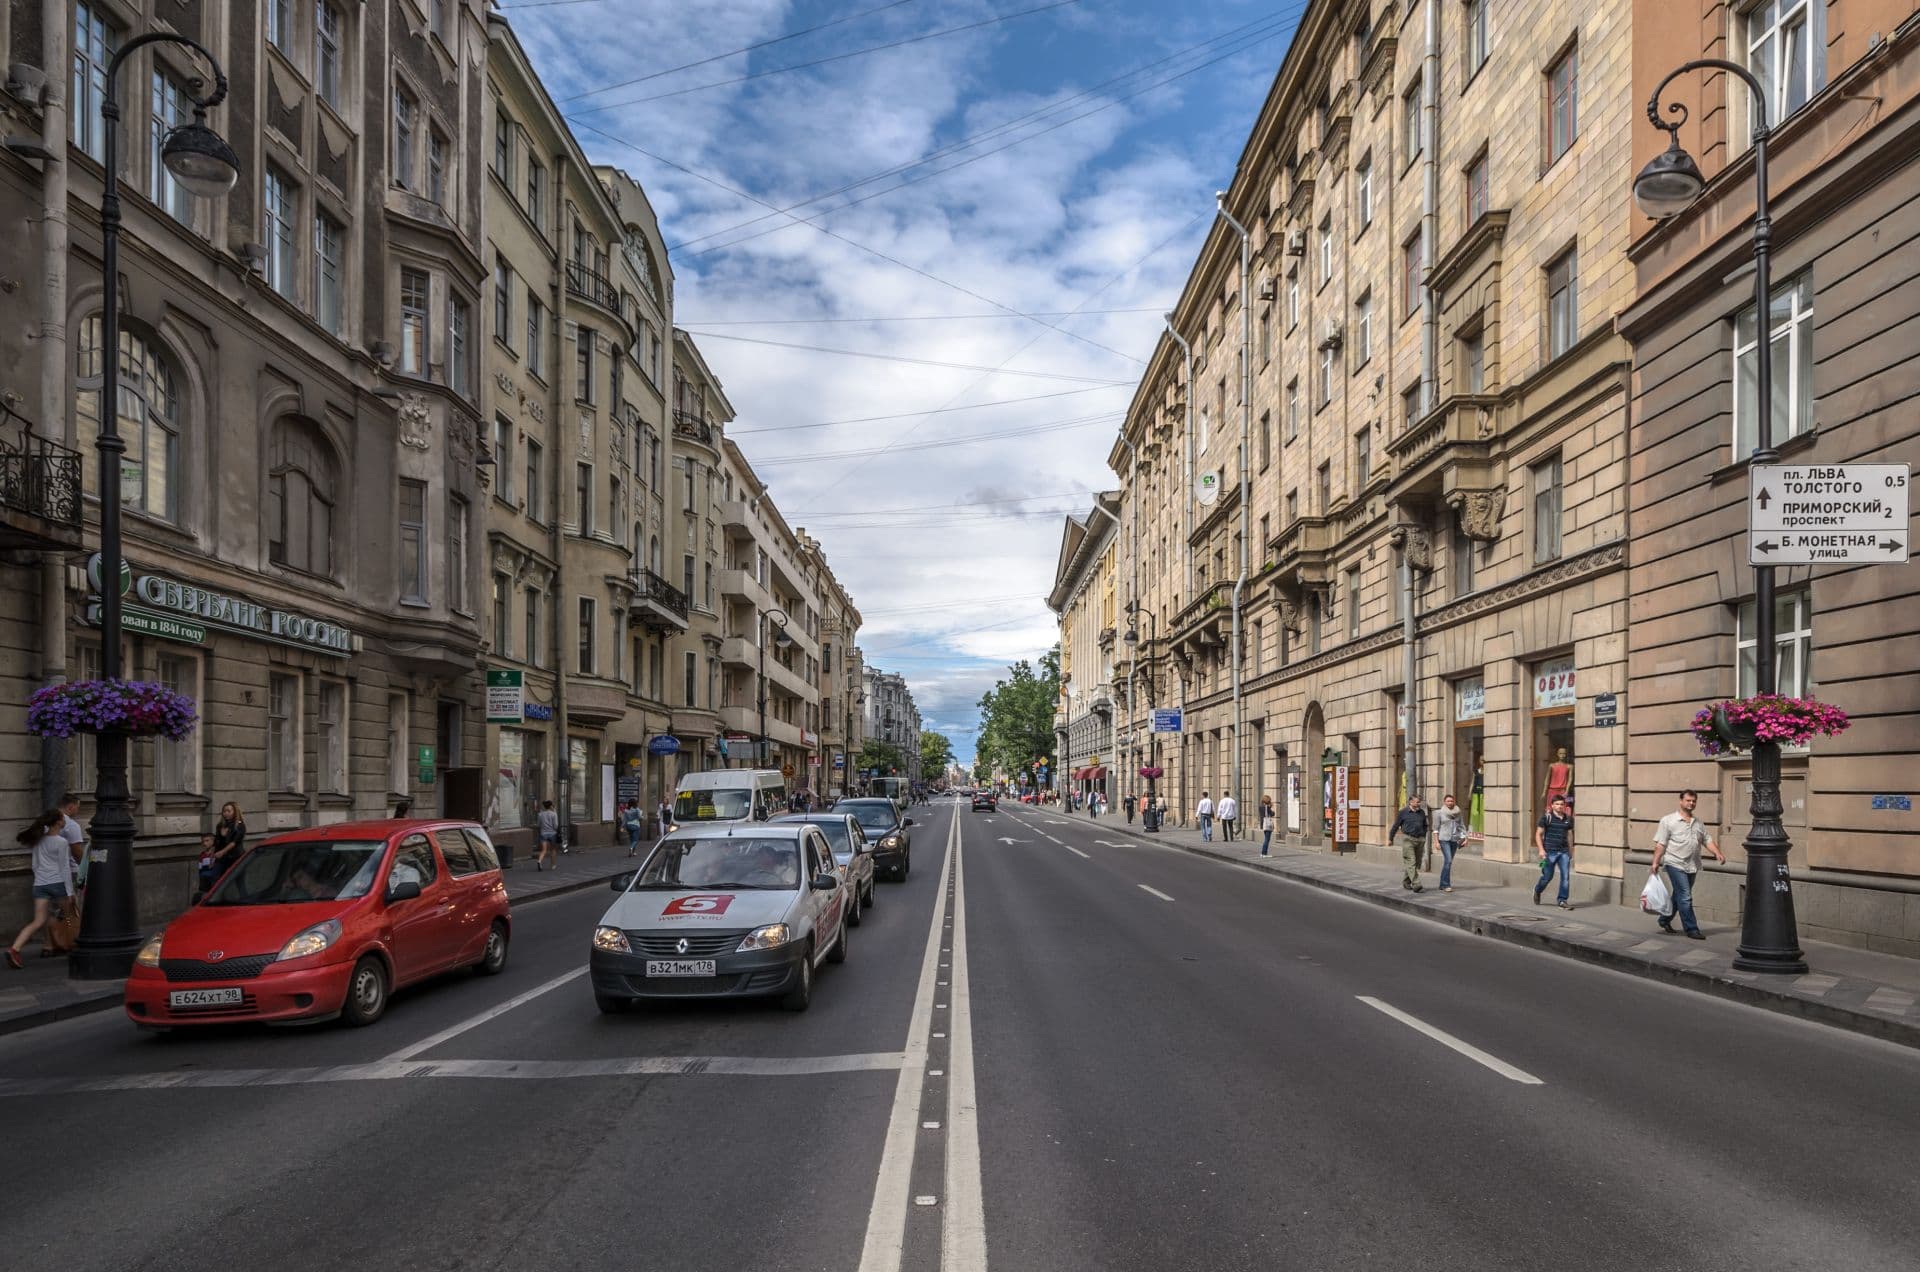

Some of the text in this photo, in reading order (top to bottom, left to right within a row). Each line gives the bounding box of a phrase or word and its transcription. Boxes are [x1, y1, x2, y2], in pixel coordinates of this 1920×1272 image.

[1783, 468, 1846, 480] пл. ЛЬВА
[1783, 482, 1862, 494] ТОЛСТОГО
[1885, 476, 1905, 488] 0,5
[1782, 499, 1881, 514] ПРИМОРСКИЙ
[1884, 507, 1892, 519] 2
[1782, 516, 1846, 528] проспект
[1782, 535, 1876, 547] Б. МОНЕТНАЯ
[1809, 549, 1848, 560] улица
[138, 575, 351, 650] СБЕРБАНК РОССИИ
[150, 621, 158, 630] в
[159, 621, 180, 635] 1841
[181, 628, 204, 642] году
[1538, 671, 1575, 693] ОБУВ
[678, 897, 719, 911] 5
[225, 989, 238, 999] 98
